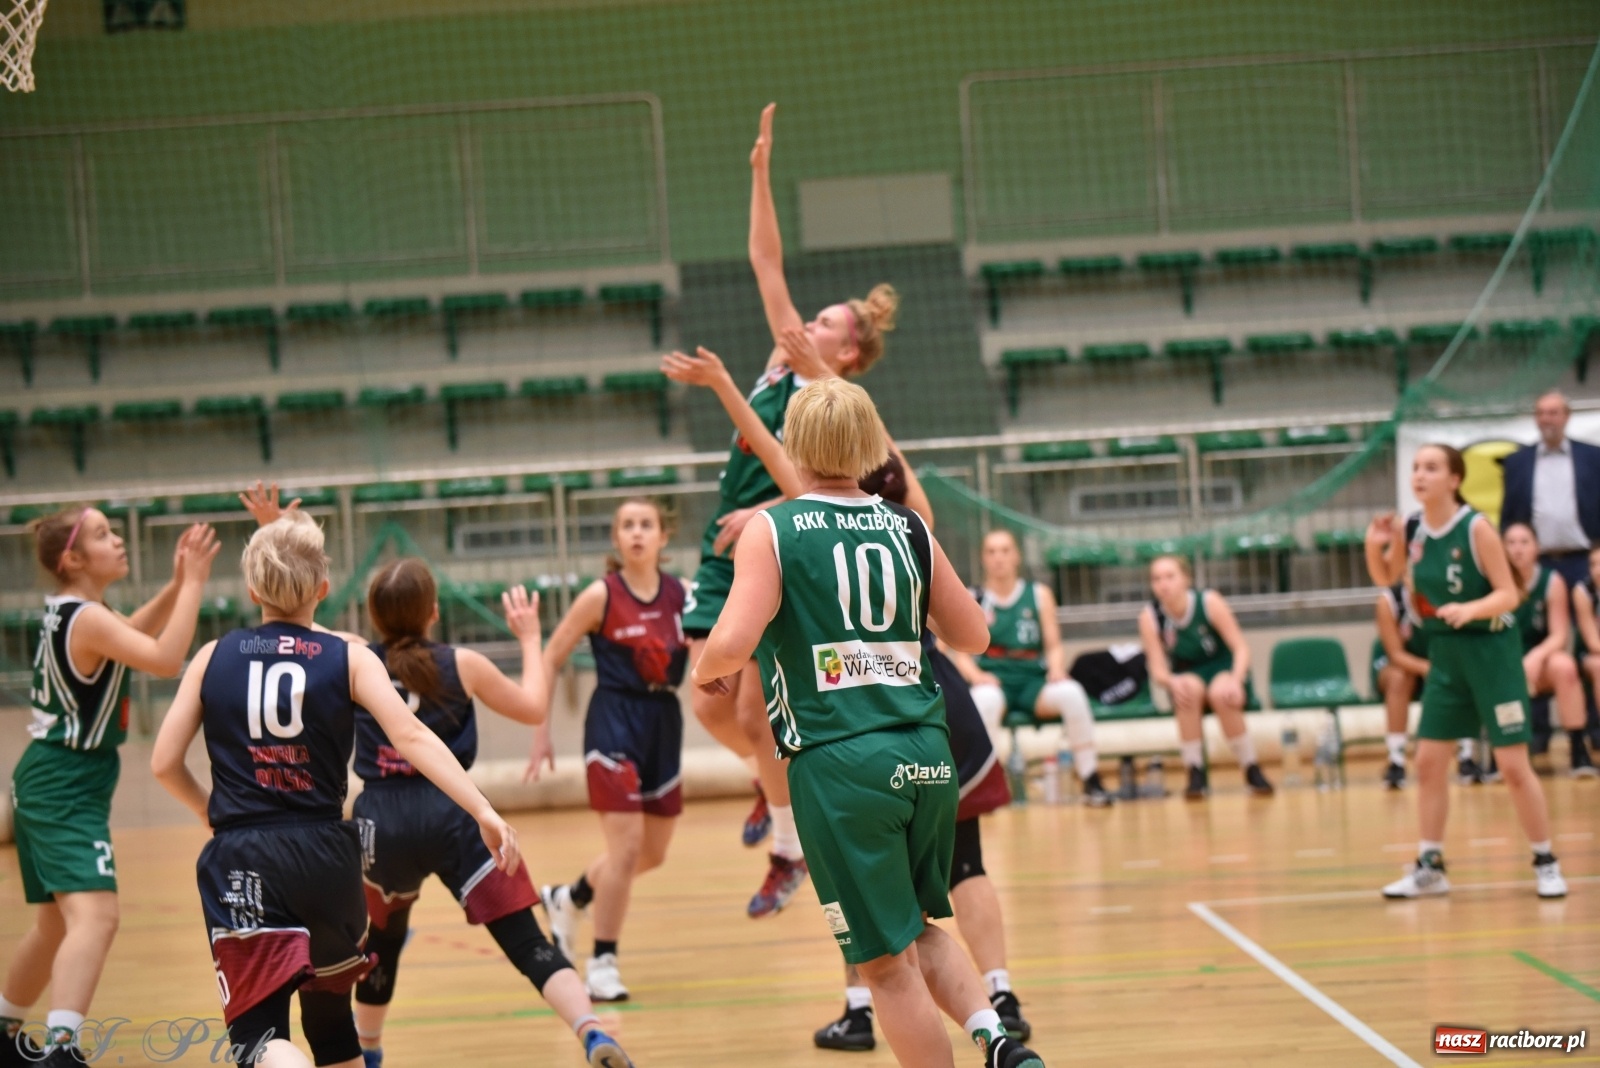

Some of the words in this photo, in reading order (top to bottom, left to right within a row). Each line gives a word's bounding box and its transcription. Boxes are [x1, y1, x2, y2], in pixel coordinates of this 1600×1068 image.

[792, 511, 829, 532] RKK
[832, 541, 898, 632] 10
[1446, 563, 1463, 595] 5
[247, 660, 307, 739] 10
[93, 839, 117, 877] 2
